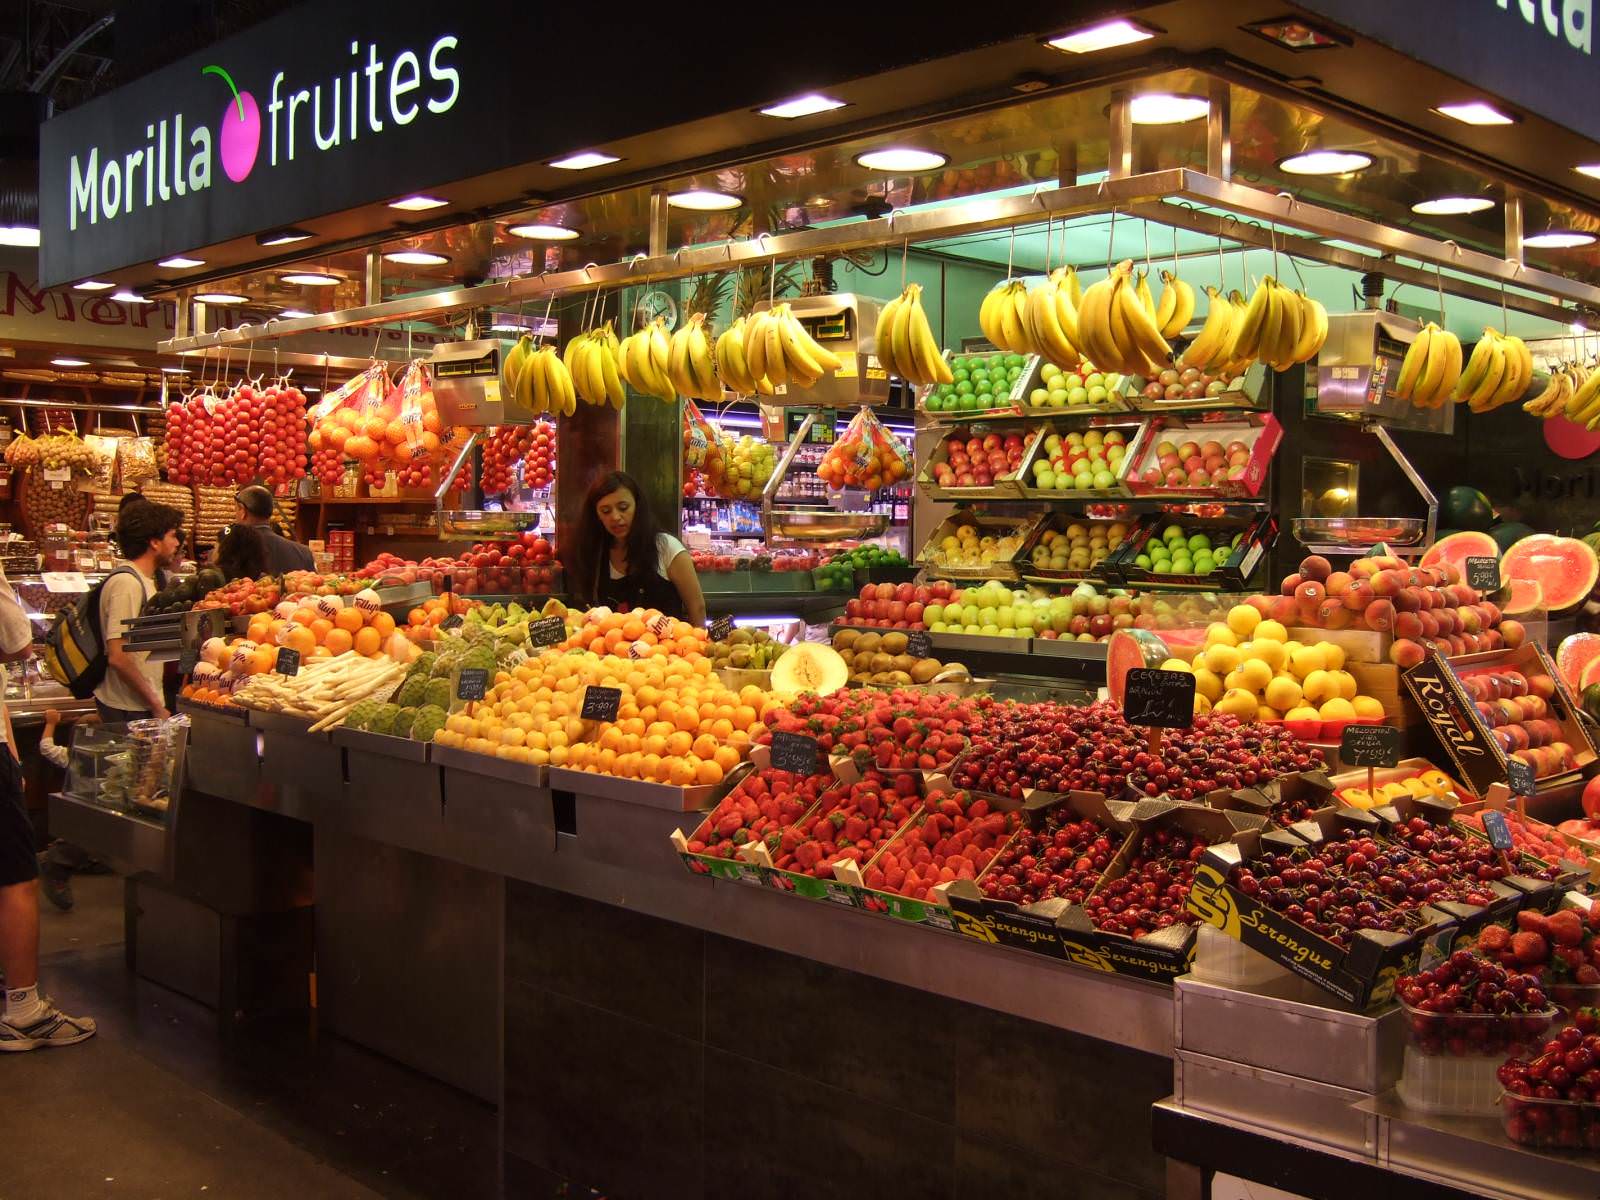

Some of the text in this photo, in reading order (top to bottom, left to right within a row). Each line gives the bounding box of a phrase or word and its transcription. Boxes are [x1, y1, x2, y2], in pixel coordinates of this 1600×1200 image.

[70, 35, 461, 231] Morilla fruites
[1411, 672, 1485, 756] Royal
[981, 915, 1057, 942] Serengue
[1239, 910, 1333, 970] Serengue
[1096, 946, 1179, 973] Serengue
